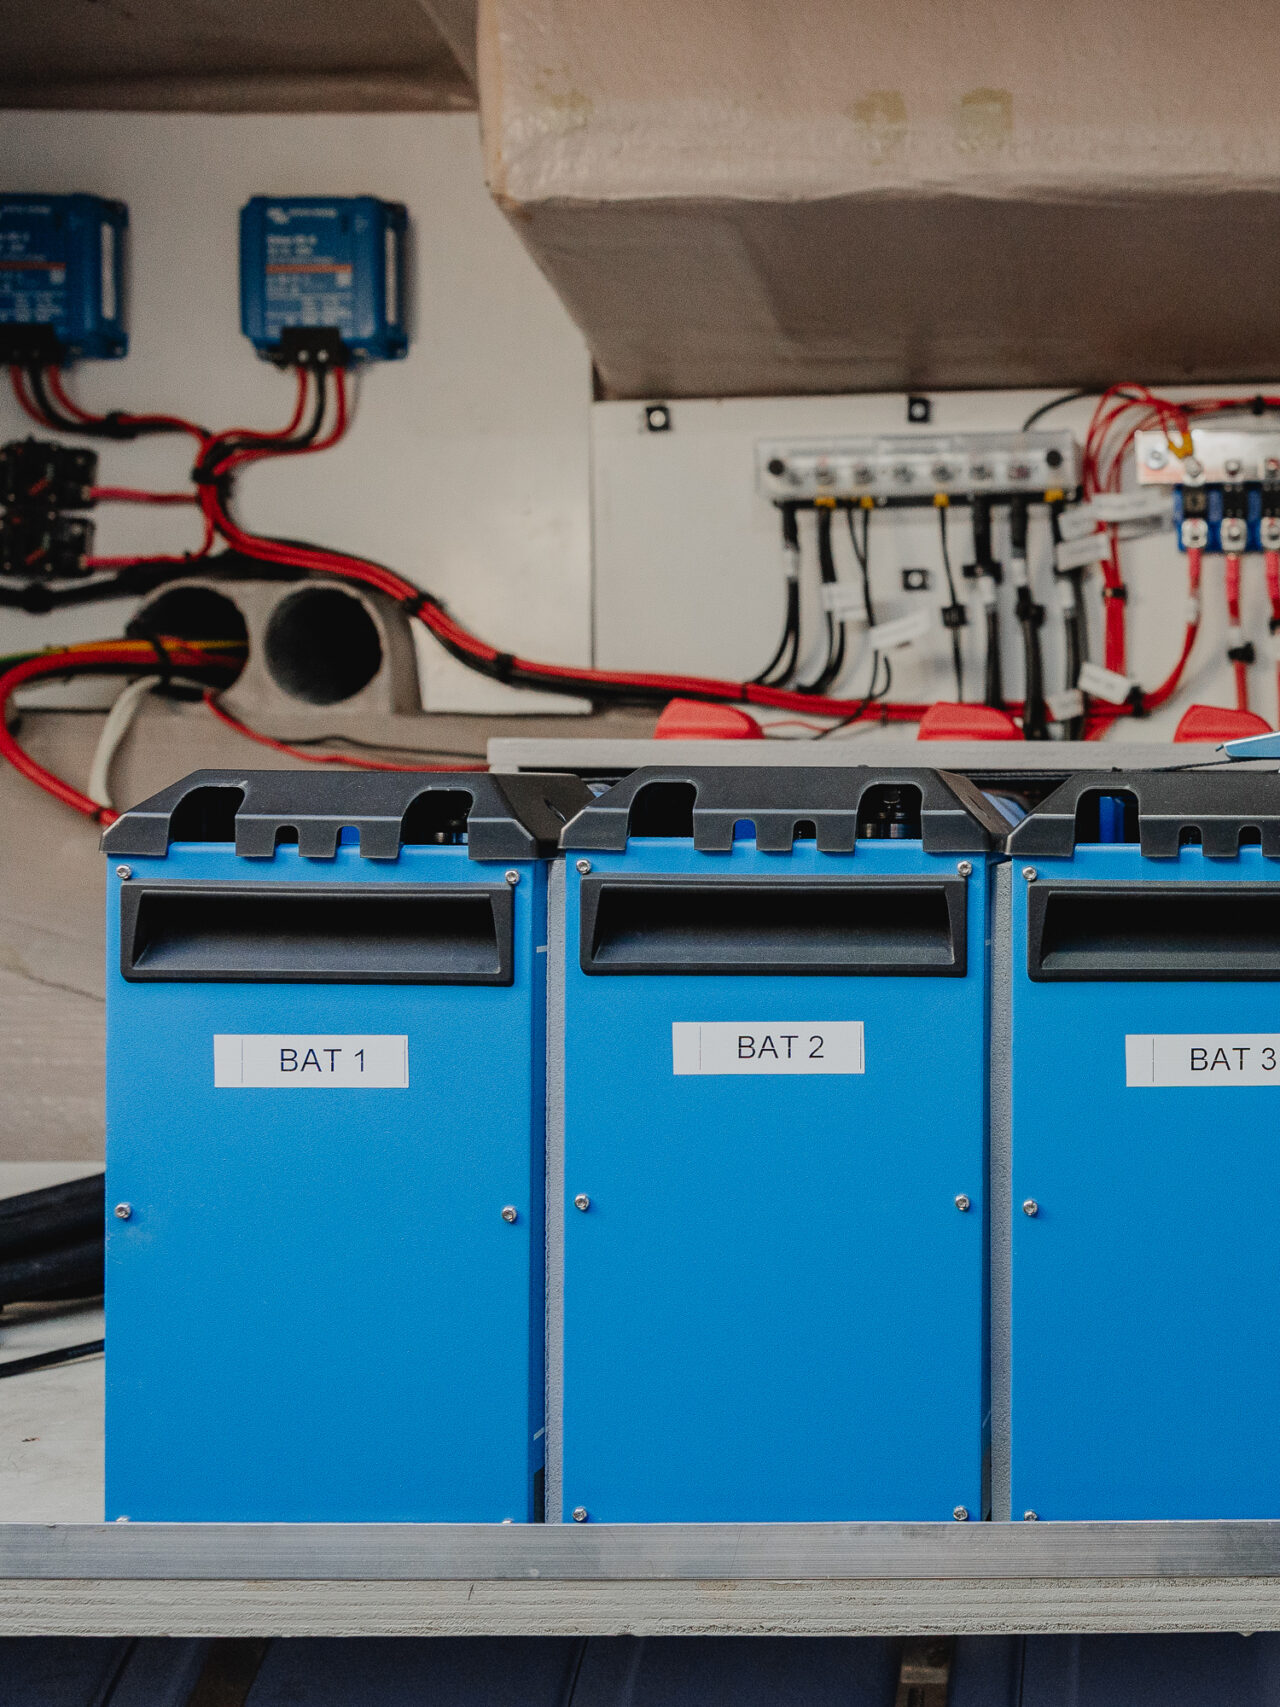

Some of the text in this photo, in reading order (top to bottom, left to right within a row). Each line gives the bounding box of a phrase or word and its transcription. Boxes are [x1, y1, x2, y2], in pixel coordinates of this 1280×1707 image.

[738, 1035, 824, 1058] BAT 2
[280, 1048, 364, 1072] BAT 1
[1190, 1047, 1276, 1070] BAT 3
